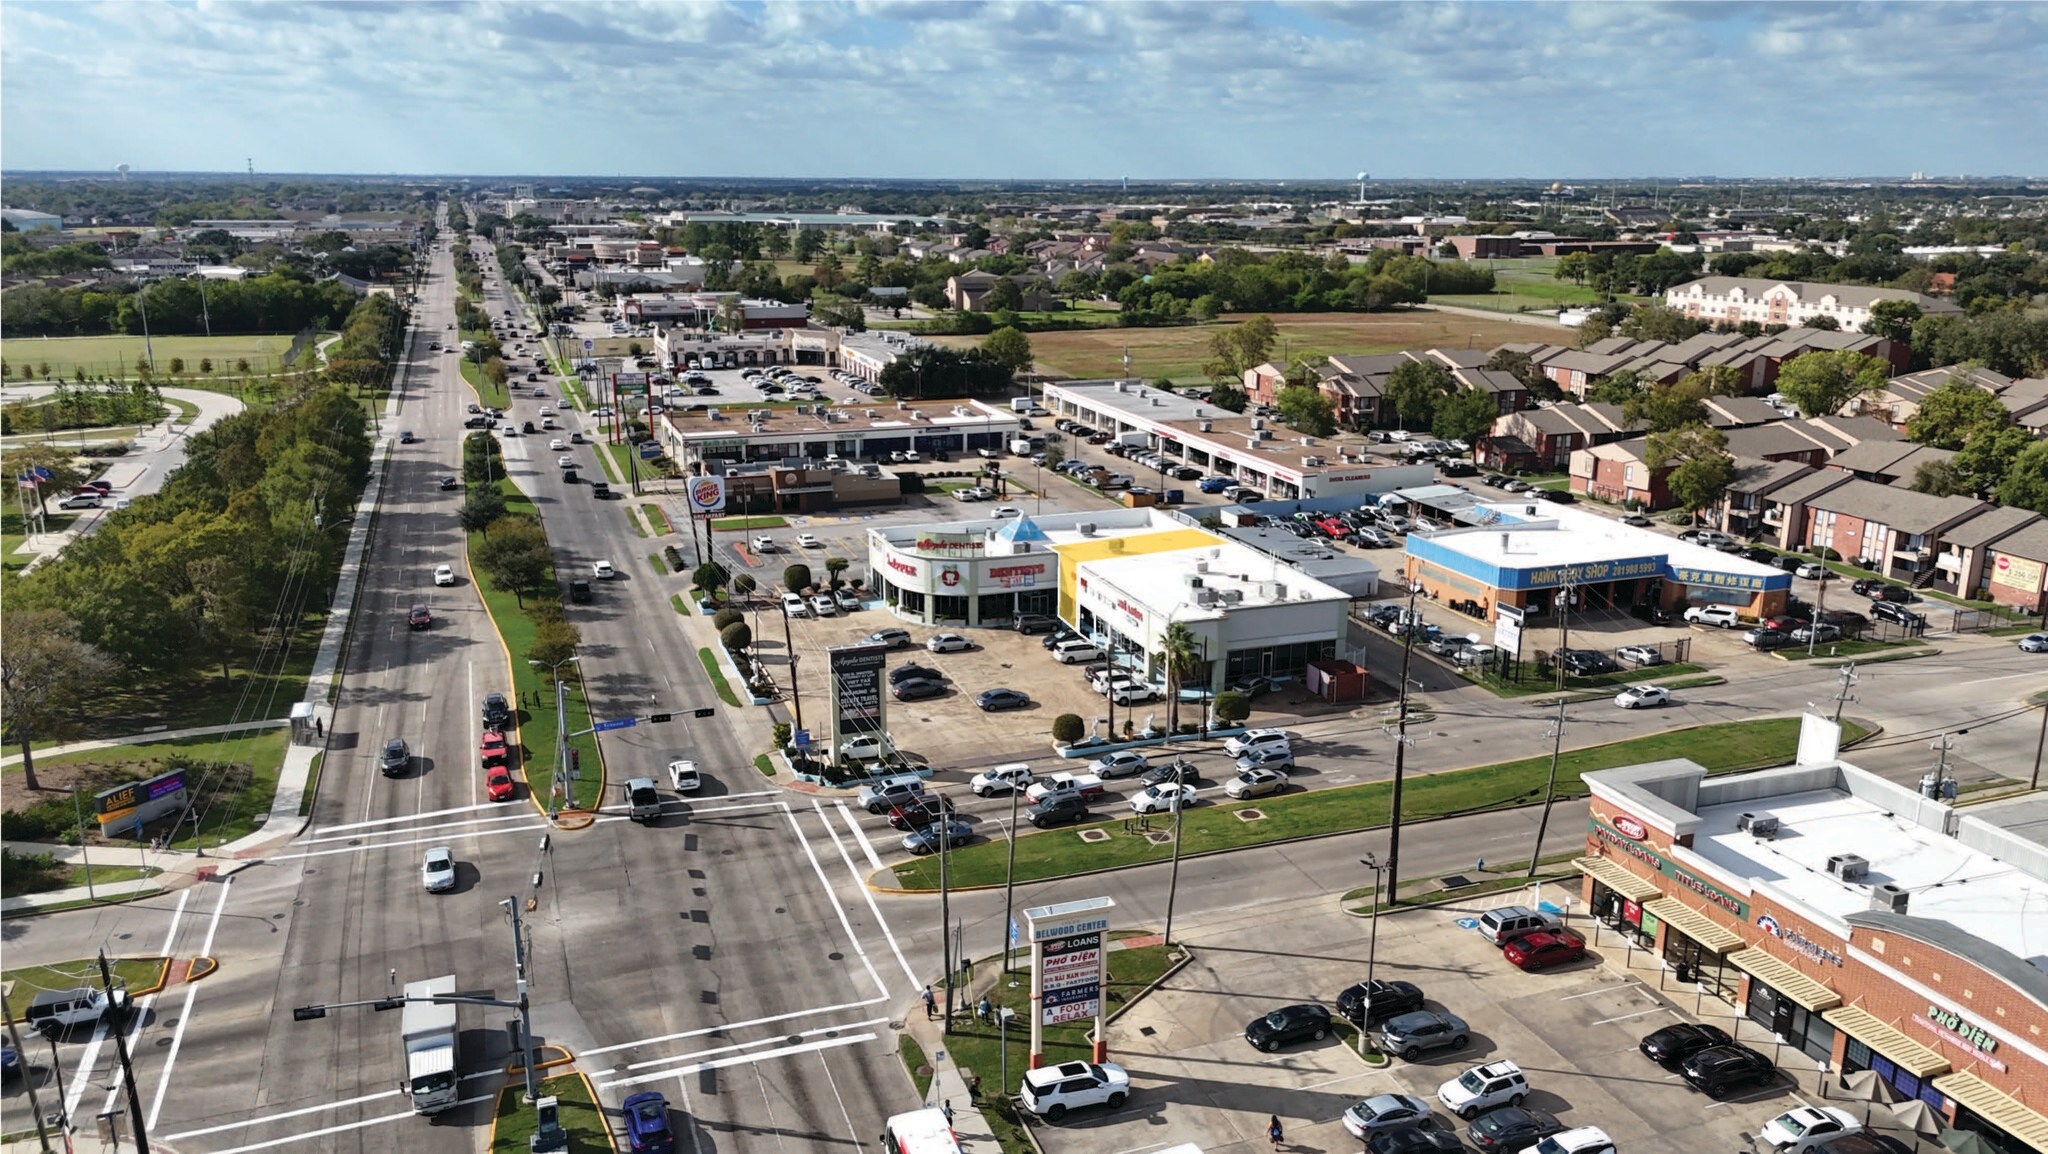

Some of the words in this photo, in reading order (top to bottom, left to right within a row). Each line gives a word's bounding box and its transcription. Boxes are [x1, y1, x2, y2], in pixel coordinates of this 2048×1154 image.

[695, 484, 718, 496] BURGER
[697, 490, 720, 502] KING
[1530, 569, 1557, 584] HAWK
[1585, 564, 1609, 579] SHOP
[859, 654, 884, 663] DENTISTS
[106, 787, 135, 806] ALIEF
[1594, 825, 1630, 854] PAYDAY
[1629, 846, 1661, 869] LOANS
[1675, 869, 1704, 895] TITLE
[1703, 886, 1740, 913] LOANS
[1036, 925, 1075, 939] BELWOOD
[1077, 920, 1107, 932] CENTER
[1067, 936, 1099, 948] LOANS
[1061, 985, 1099, 998] FARMERS
[1046, 1008, 1053, 1016] A
[1060, 1002, 1087, 1014] FOOT
[1053, 1010, 1088, 1023] RELAX
